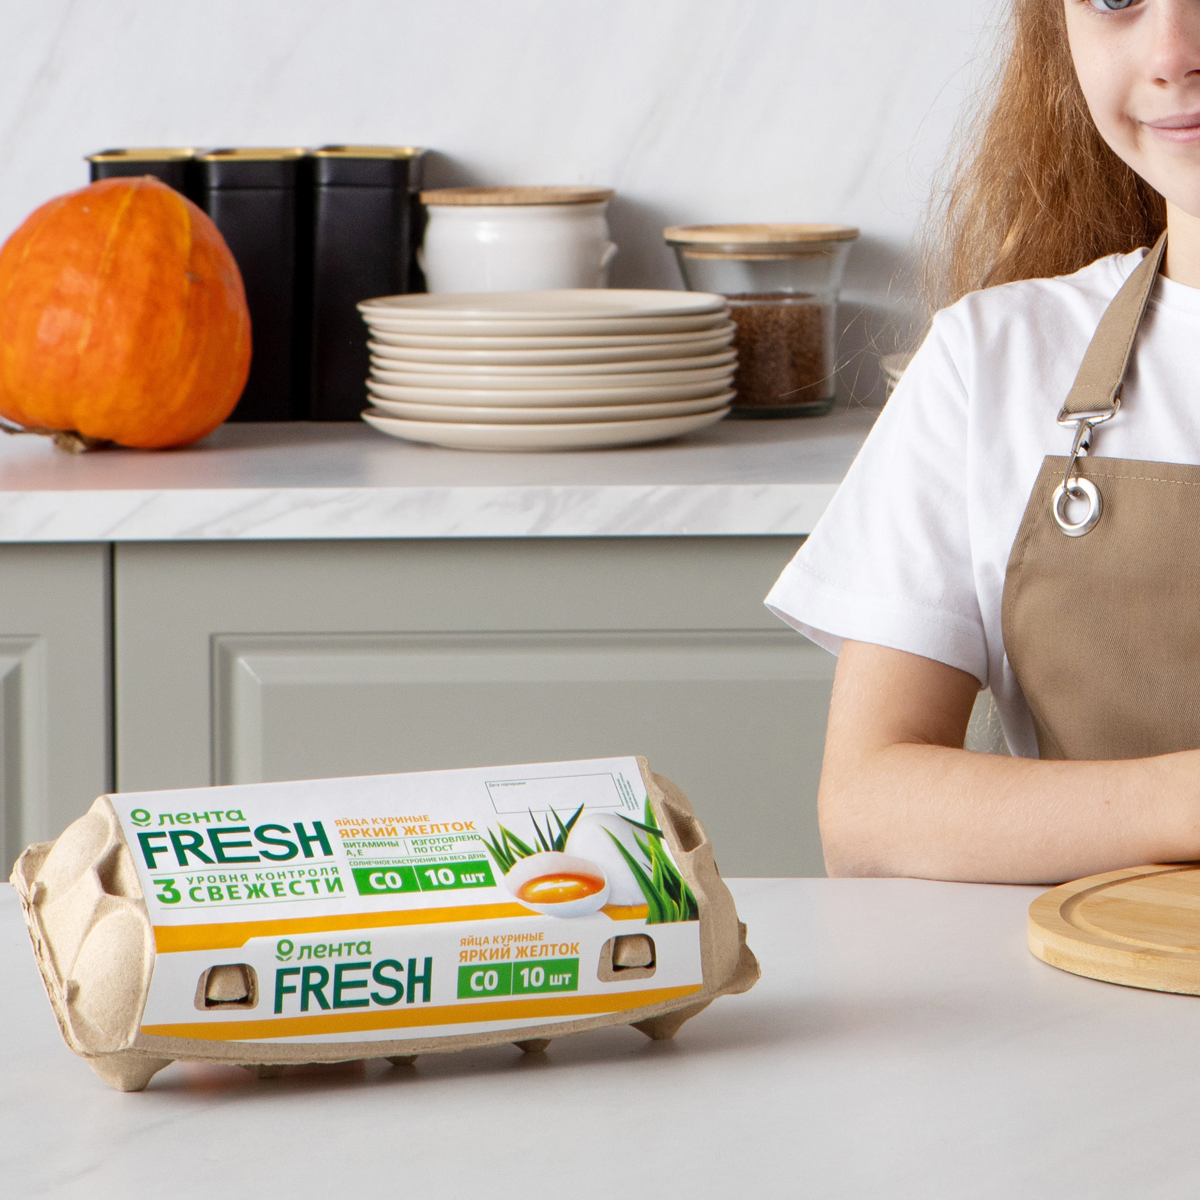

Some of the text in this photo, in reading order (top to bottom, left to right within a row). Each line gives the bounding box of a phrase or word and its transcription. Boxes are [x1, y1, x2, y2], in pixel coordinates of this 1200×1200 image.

[158, 809, 247, 826] лента
[334, 814, 431, 827] ЯЙЦА КУРИНЫЕ
[338, 820, 477, 839] ЯРКИЙ ЖЕЛТОК
[136, 820, 334, 870] FRESH
[342, 840, 399, 849] ВИТАМИНЫ
[411, 834, 481, 846] ИЗГОТОВЛЕНО
[413, 844, 454, 854] ПО ГОСТ
[349, 859, 392, 867] СОЛНЕЧНОЕ
[393, 856, 437, 865] НАСТРОЕНИЕ
[186, 866, 340, 886] УРОВНЯ КОНТРОЛЯ
[424, 868, 455, 886] 10
[460, 873, 486, 884] шт
[153, 878, 182, 904] 3
[188, 876, 345, 903] СВЕЖЕСТИ
[459, 932, 544, 947] ЯЙЦА КУРИНЫЕ
[297, 940, 372, 960] лента
[458, 942, 580, 963] ЯРКИЙ ЖЕЛТОК
[273, 956, 433, 1014] FRESH
[519, 966, 545, 988] 10
[549, 972, 572, 986] шт
